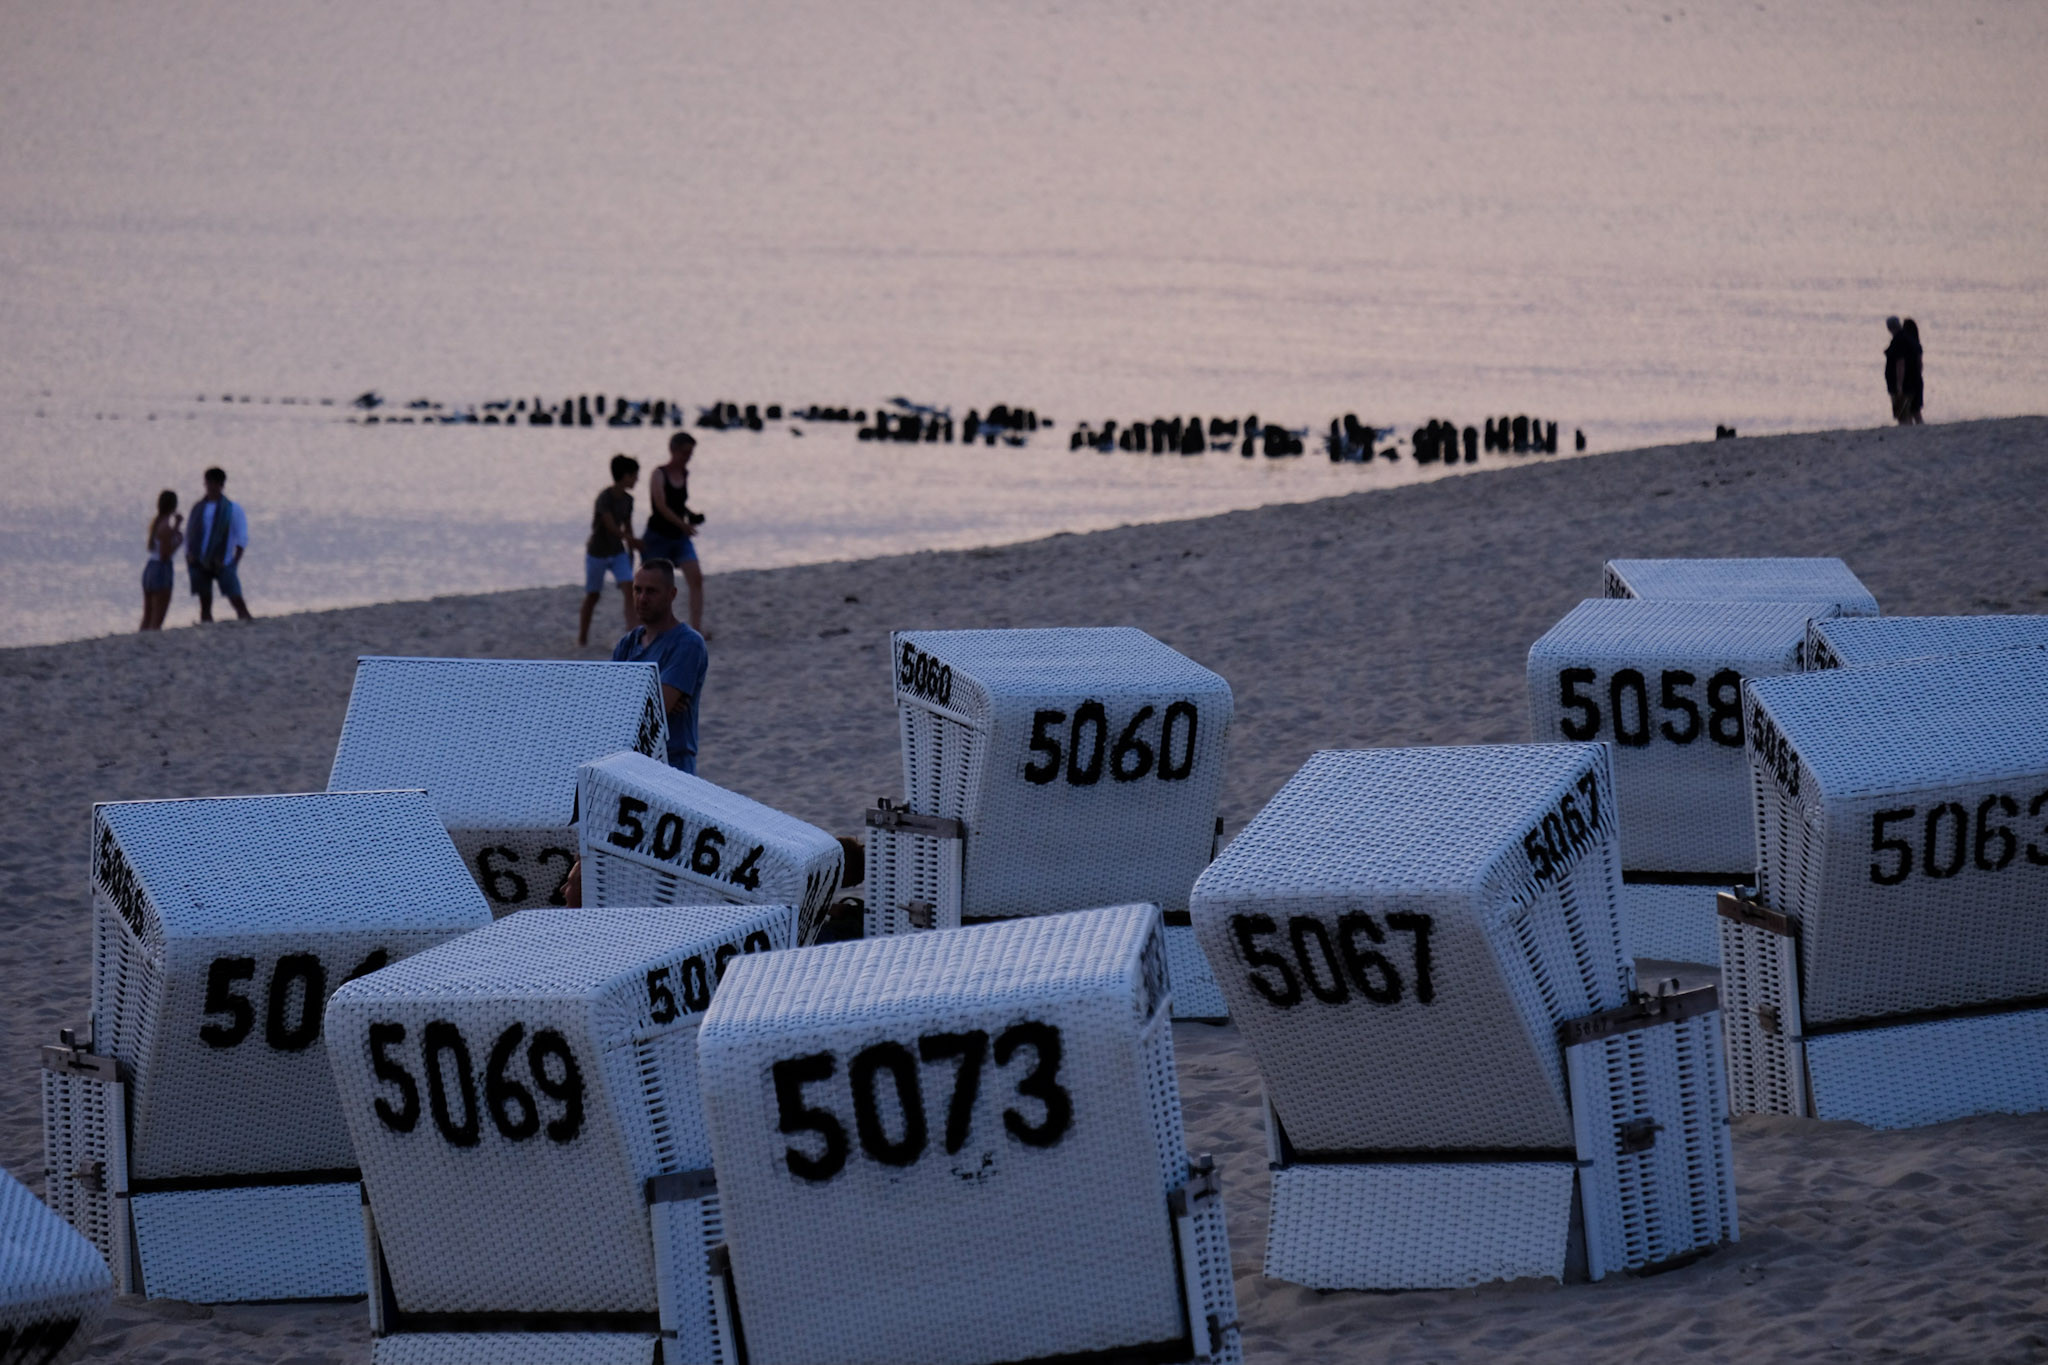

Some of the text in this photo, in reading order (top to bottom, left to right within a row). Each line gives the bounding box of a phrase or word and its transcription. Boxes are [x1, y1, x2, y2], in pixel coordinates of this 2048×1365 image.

[900, 640, 953, 707] 5060
[1559, 667, 1744, 747] 5058
[1023, 700, 1198, 786] 5060
[607, 796, 764, 892] 5064
[1525, 769, 1600, 875] 5067
[1230, 910, 1436, 1010] 5067
[367, 1020, 585, 1148] 5069
[770, 1020, 1073, 1183] 5073
